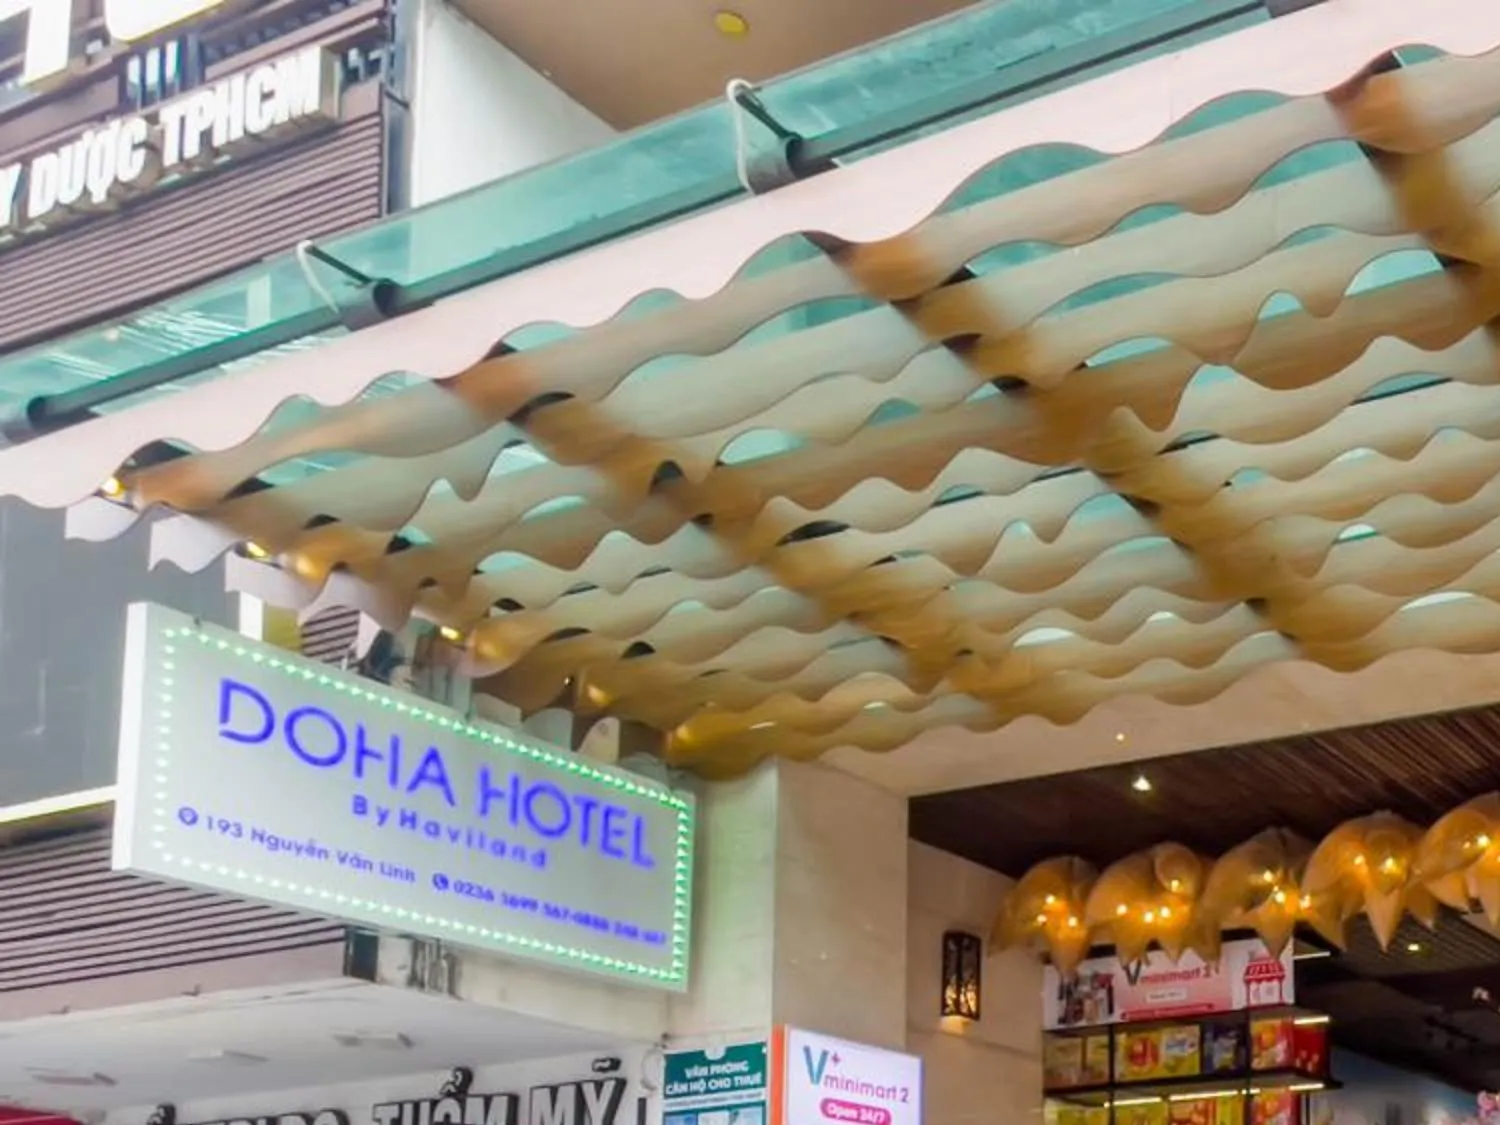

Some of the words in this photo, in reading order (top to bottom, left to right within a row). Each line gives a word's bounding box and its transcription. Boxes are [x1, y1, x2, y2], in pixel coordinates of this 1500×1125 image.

[28, 117, 148, 218] DƯỢC
[158, 45, 322, 168] TPHCM
[219, 676, 456, 807] DOHA
[479, 765, 656, 868] HOTEL
[206, 815, 243, 839] 193
[250, 826, 330, 861] Nguyễn
[379, 861, 416, 883] Linh
[824, 1073, 897, 1101] minimart
[900, 1086, 910, 1103] 2
